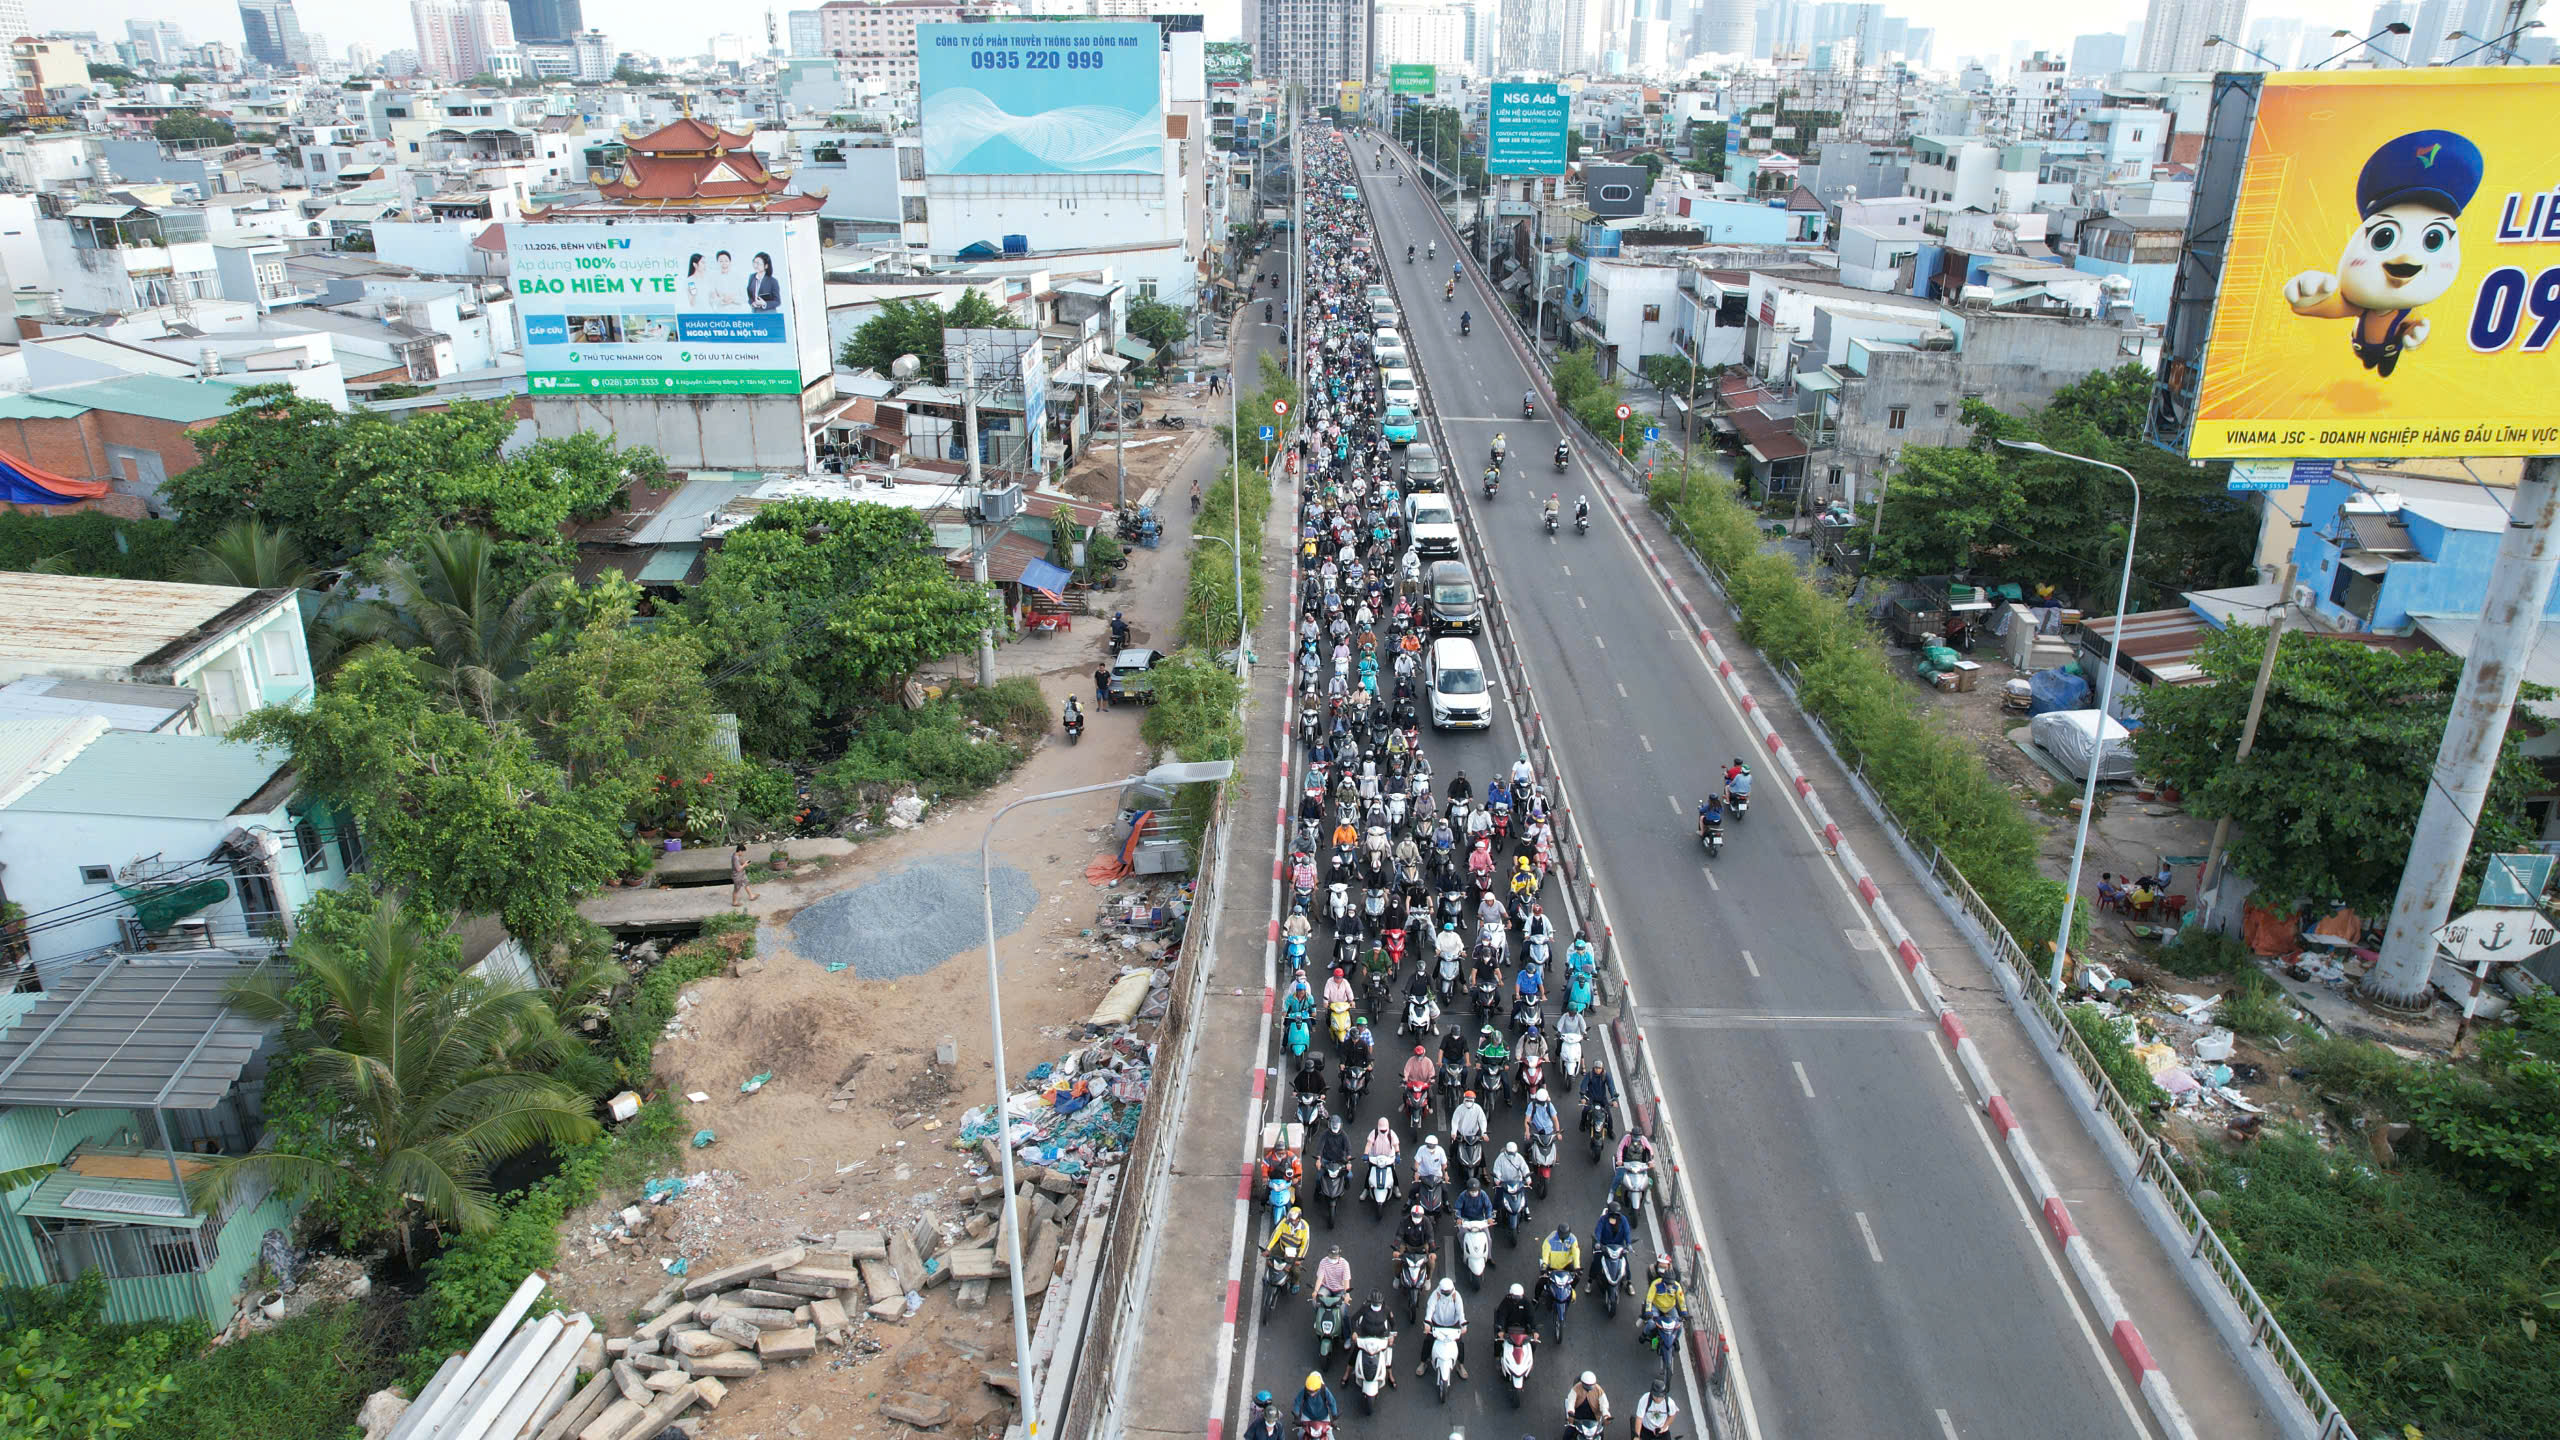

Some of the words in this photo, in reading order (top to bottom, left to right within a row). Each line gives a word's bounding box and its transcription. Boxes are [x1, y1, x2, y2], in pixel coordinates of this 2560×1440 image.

[936, 36, 958, 47] CÔNG
[961, 38, 970, 47] TY
[972, 33, 984, 47] CỔ
[1044, 35, 1071, 47] THÔNG
[1074, 37, 1090, 47] SAO
[1118, 37, 1138, 47] NAM
[971, 51, 1019, 69] 0935
[1025, 51, 1060, 69] 220
[1067, 51, 1104, 69] 999
[1503, 93, 1530, 104] NSG
[1532, 93, 1556, 104] Ads
[524, 243, 559, 252] 1.1.2026,
[607, 238, 631, 249] FV
[574, 256, 616, 270] 100%
[518, 275, 565, 294] BẢO
[570, 274, 625, 293] HIỂM
[629, 278, 644, 293] Y
[649, 274, 679, 293] TẾ
[685, 320, 708, 329] KHÁM
[709, 320, 731, 329] CHỮA
[732, 320, 754, 330] BỆNH
[616, 353, 644, 361] NHANH
[533, 377, 557, 388] FV
[601, 378, 622, 388] (028)
[640, 378, 659, 386] 3333
[2226, 431, 2276, 444] VINAMA
[2280, 431, 2306, 444] JSC
[2319, 430, 2366, 444] DOANH
[2369, 427, 2419, 447] NGHIỆP
[2422, 426, 2461, 443] HÀNG
[2464, 424, 2493, 442] ĐẦU
[2495, 425, 2527, 442] LĨNH
[2532, 427, 2559, 446] VỰC
[2529, 928, 2555, 945] 100
